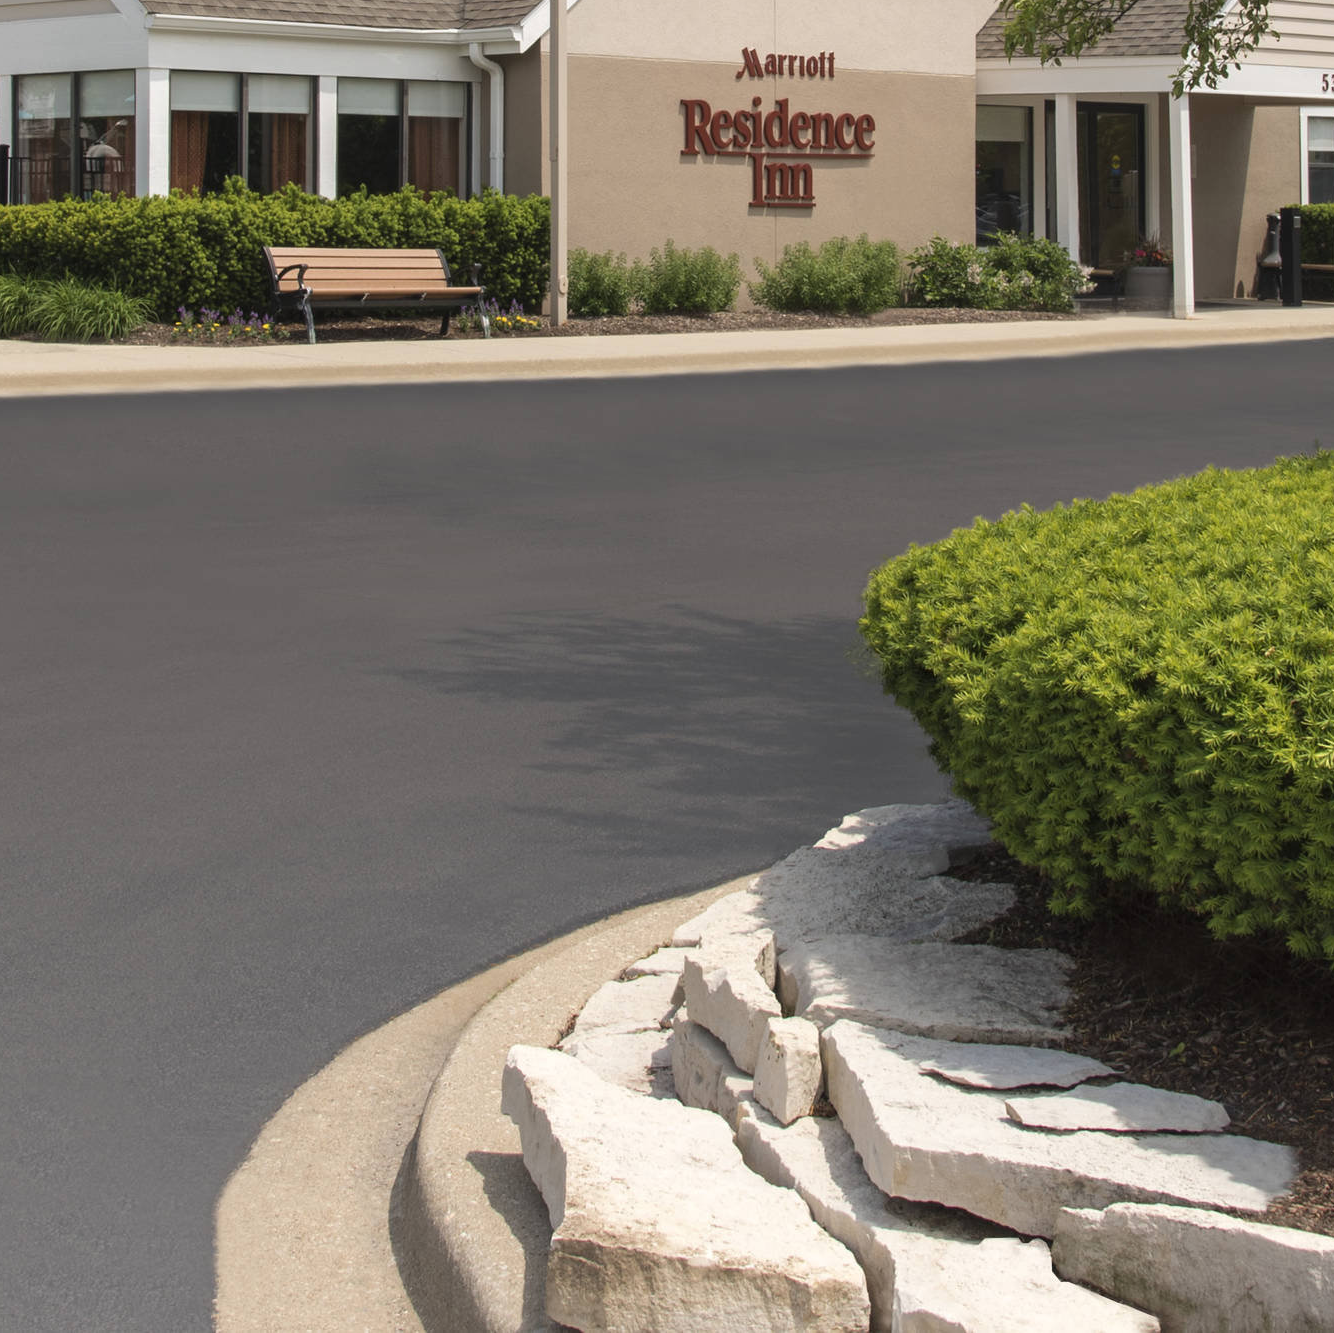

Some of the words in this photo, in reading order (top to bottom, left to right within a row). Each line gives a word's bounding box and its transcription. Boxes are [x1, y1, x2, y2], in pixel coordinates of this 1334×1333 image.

[735, 47, 835, 78] Marriott
[680, 96, 876, 156] Residence
[748, 152, 816, 208] Inn
